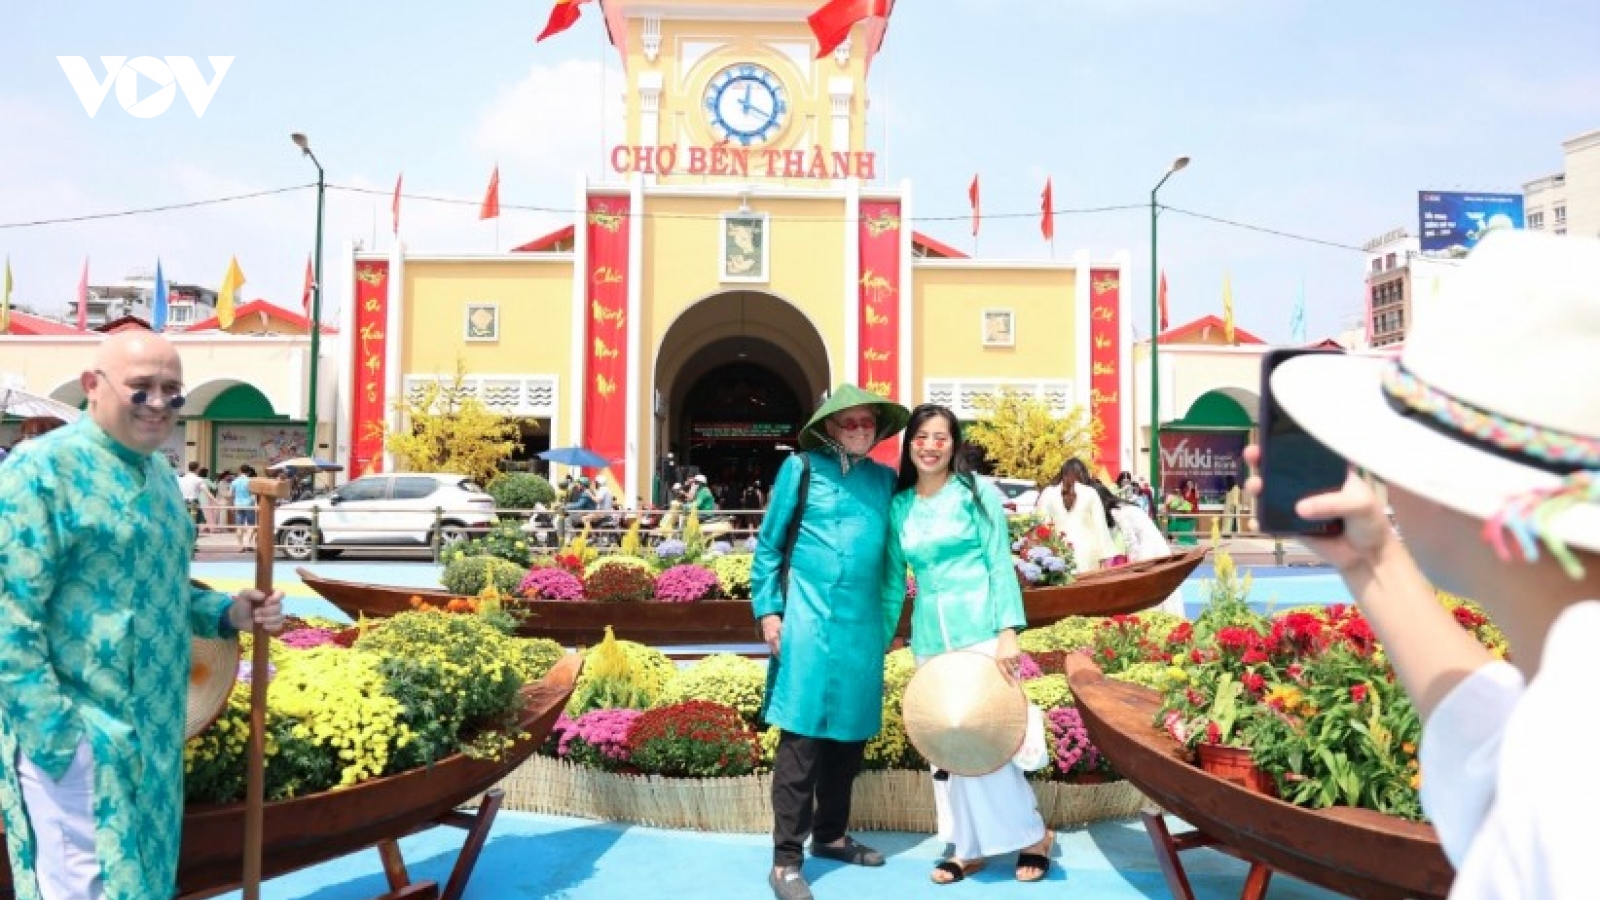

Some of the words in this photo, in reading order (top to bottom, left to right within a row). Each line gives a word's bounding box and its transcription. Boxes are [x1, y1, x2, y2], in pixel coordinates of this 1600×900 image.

[611, 143, 676, 175] CHỢ
[688, 138, 749, 176] BẾN
[763, 145, 876, 179] THÀNH
[1159, 438, 1211, 468] Vikki
